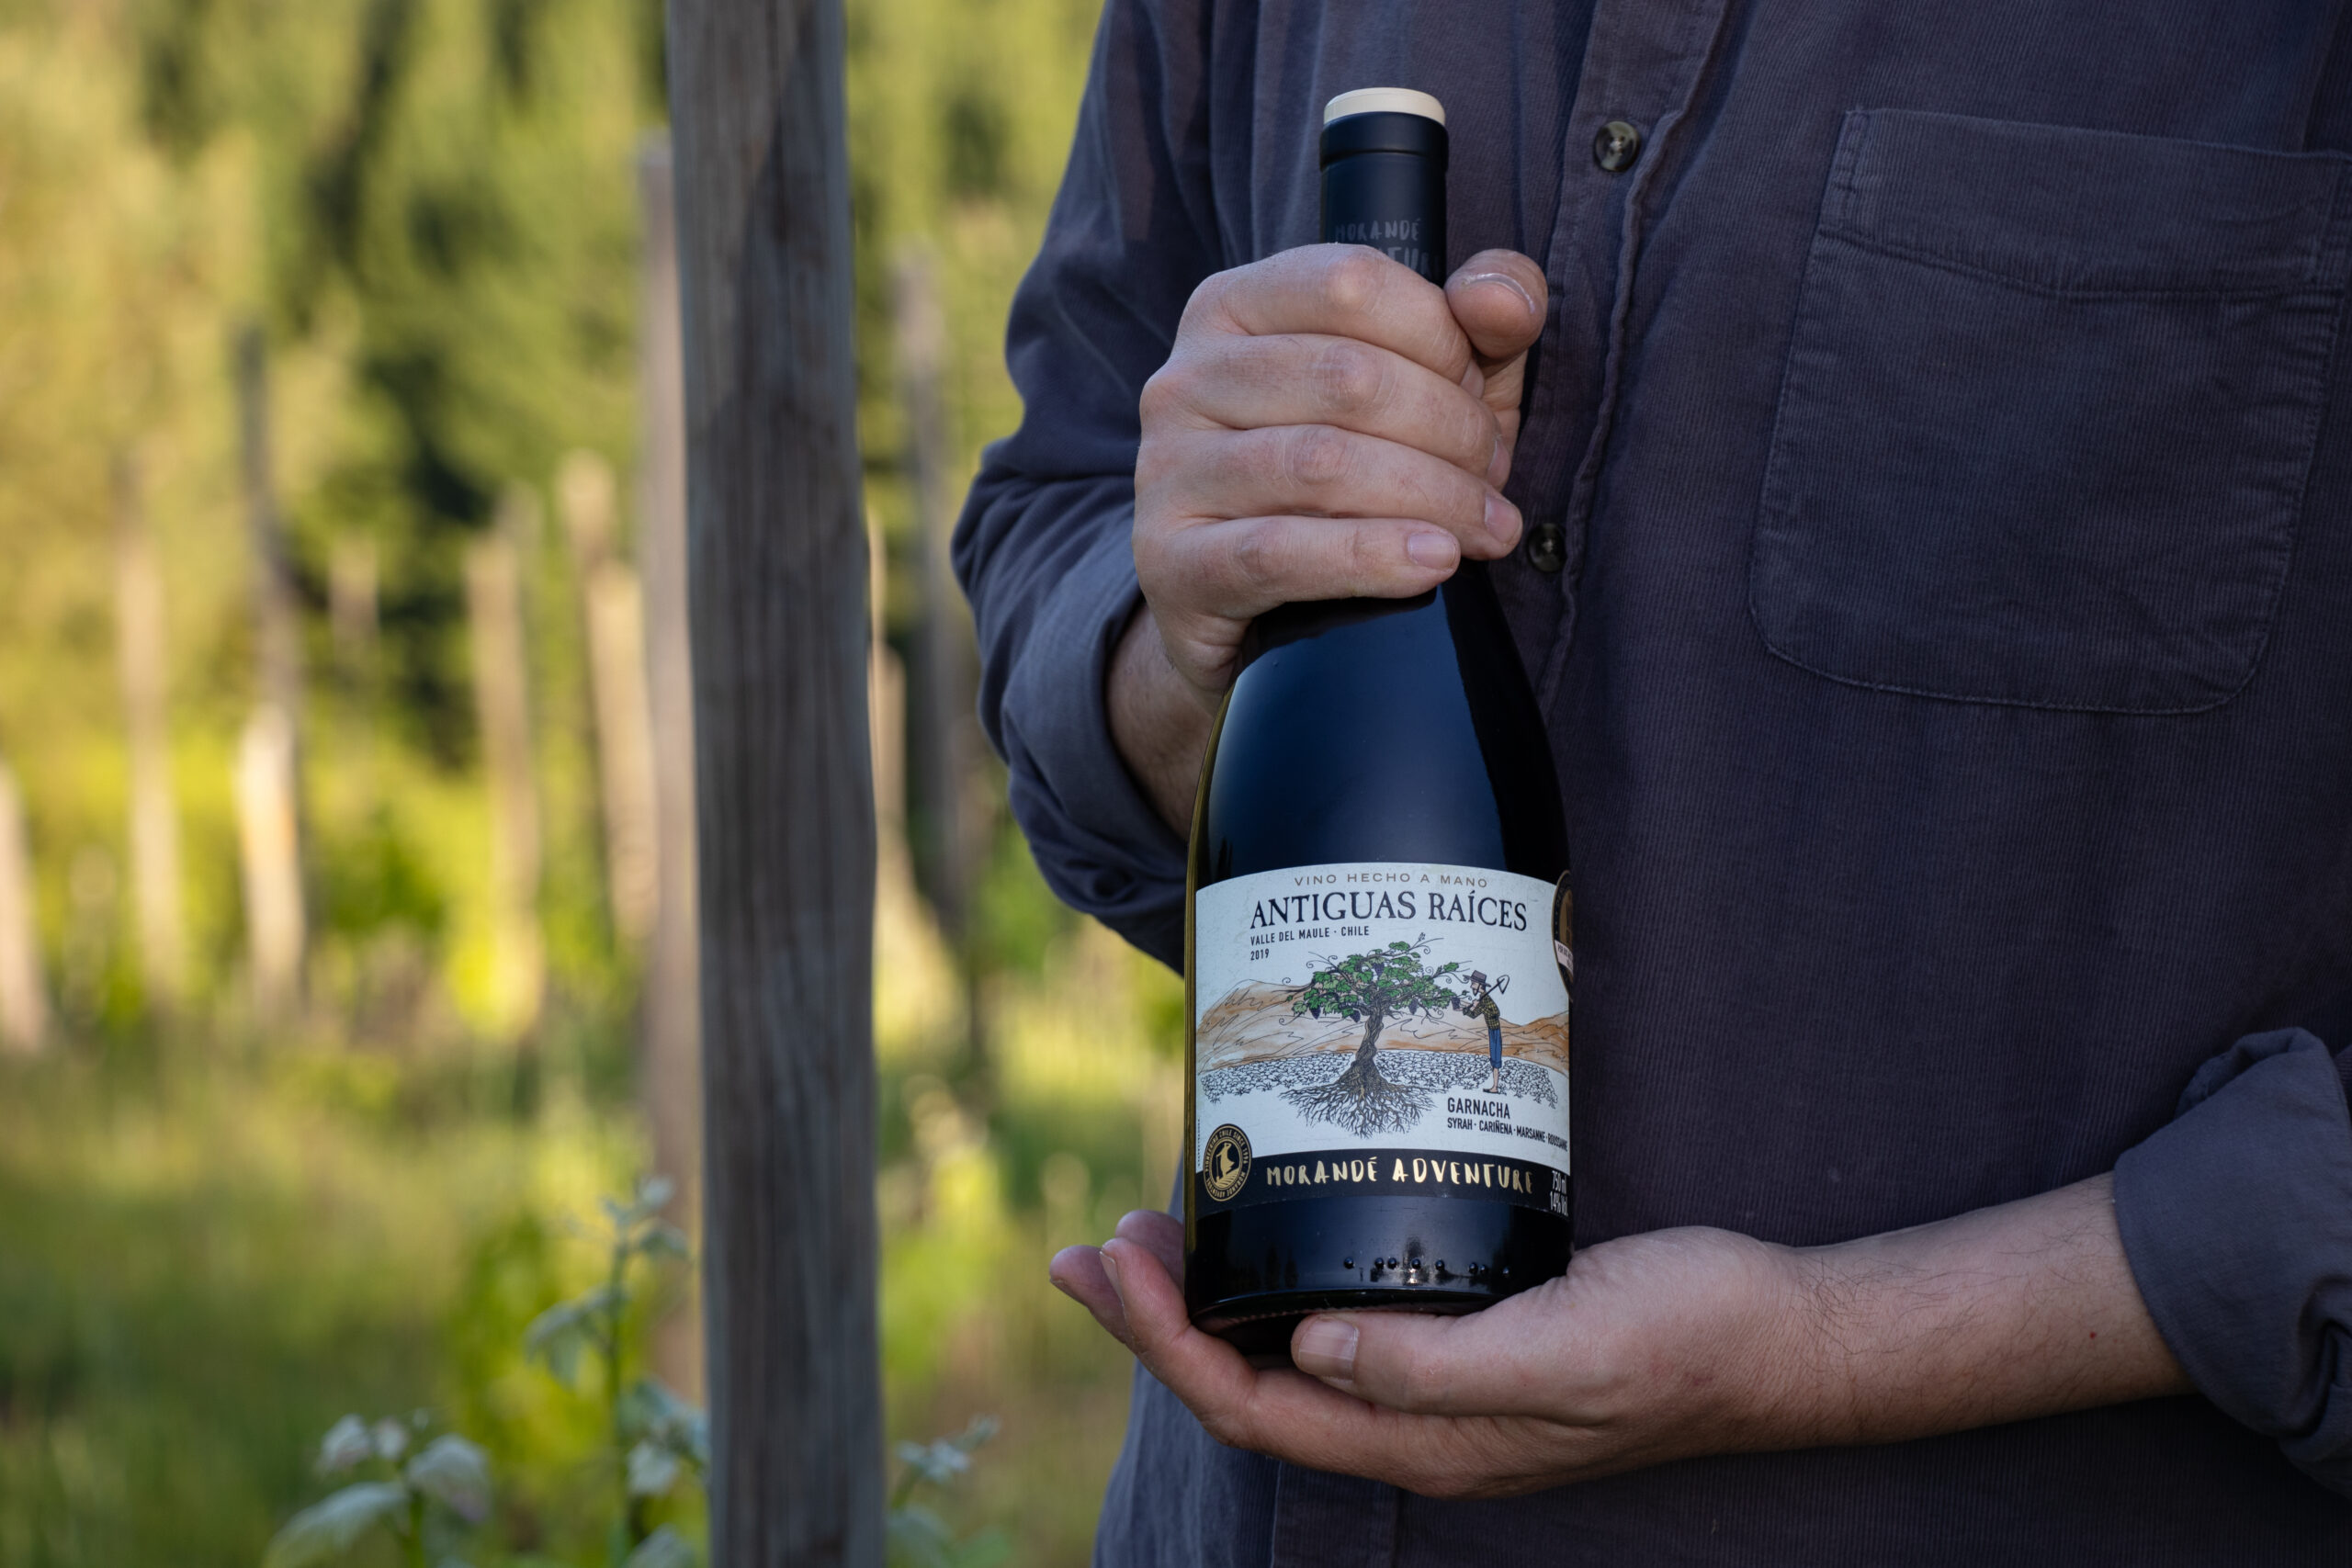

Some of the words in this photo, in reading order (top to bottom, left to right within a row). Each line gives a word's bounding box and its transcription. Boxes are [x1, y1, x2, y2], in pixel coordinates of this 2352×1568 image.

[1295, 874, 1337, 886] VINO
[1347, 873, 1410, 882] HECHO
[1420, 874, 1430, 883] A
[1441, 875, 1487, 887] MANO
[1250, 890, 1416, 930] ANTIGUAS
[1428, 890, 1527, 931] RAÍCES
[1250, 932, 1275, 946] VALLE
[1279, 931, 1295, 942] DEL
[1299, 927, 1330, 940] MAULE
[1341, 926, 1369, 936] CHILE
[1250, 948, 1270, 961] 2019
[1447, 1097, 1510, 1119] GARNACHA
[1447, 1117, 1473, 1130] SYRAH
[1479, 1120, 1513, 1135] CARIÑENA
[1516, 1125, 1545, 1143] MARSANNE
[1266, 1156, 1377, 1186] MORANDÉ
[1392, 1157, 1533, 1194] ADVENTURE
